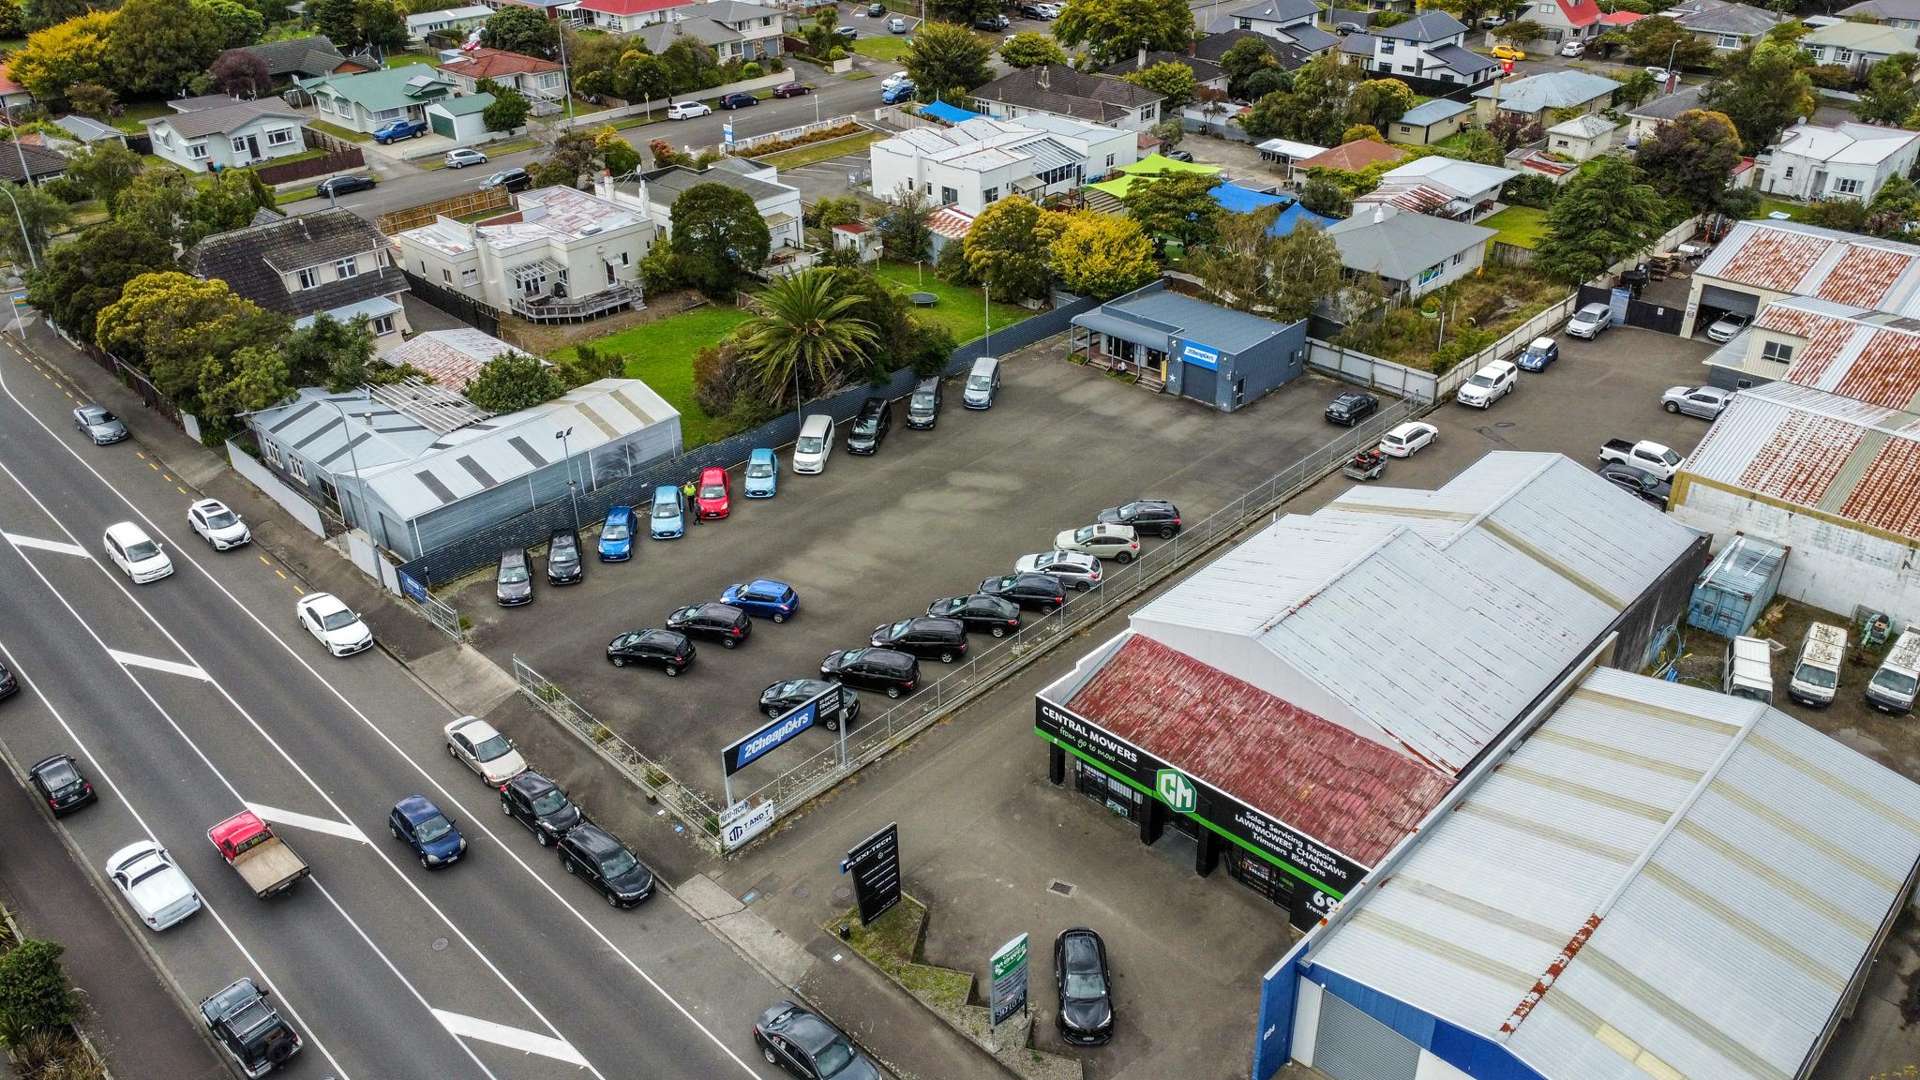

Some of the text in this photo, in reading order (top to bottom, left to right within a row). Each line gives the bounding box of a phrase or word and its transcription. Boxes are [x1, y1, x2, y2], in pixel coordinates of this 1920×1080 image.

[1042, 706, 1138, 763] CENTRAL MOWERS
[1060, 726, 1116, 762] from go to mow
[750, 813, 764, 825] AND
[1245, 811, 1337, 864] Sales Servicing Repairs
[1235, 814, 1293, 850] LAWNMOWERS
[1296, 847, 1347, 880] CHAINSAWS
[1252, 832, 1326, 877] Trimmers Ride Ons
